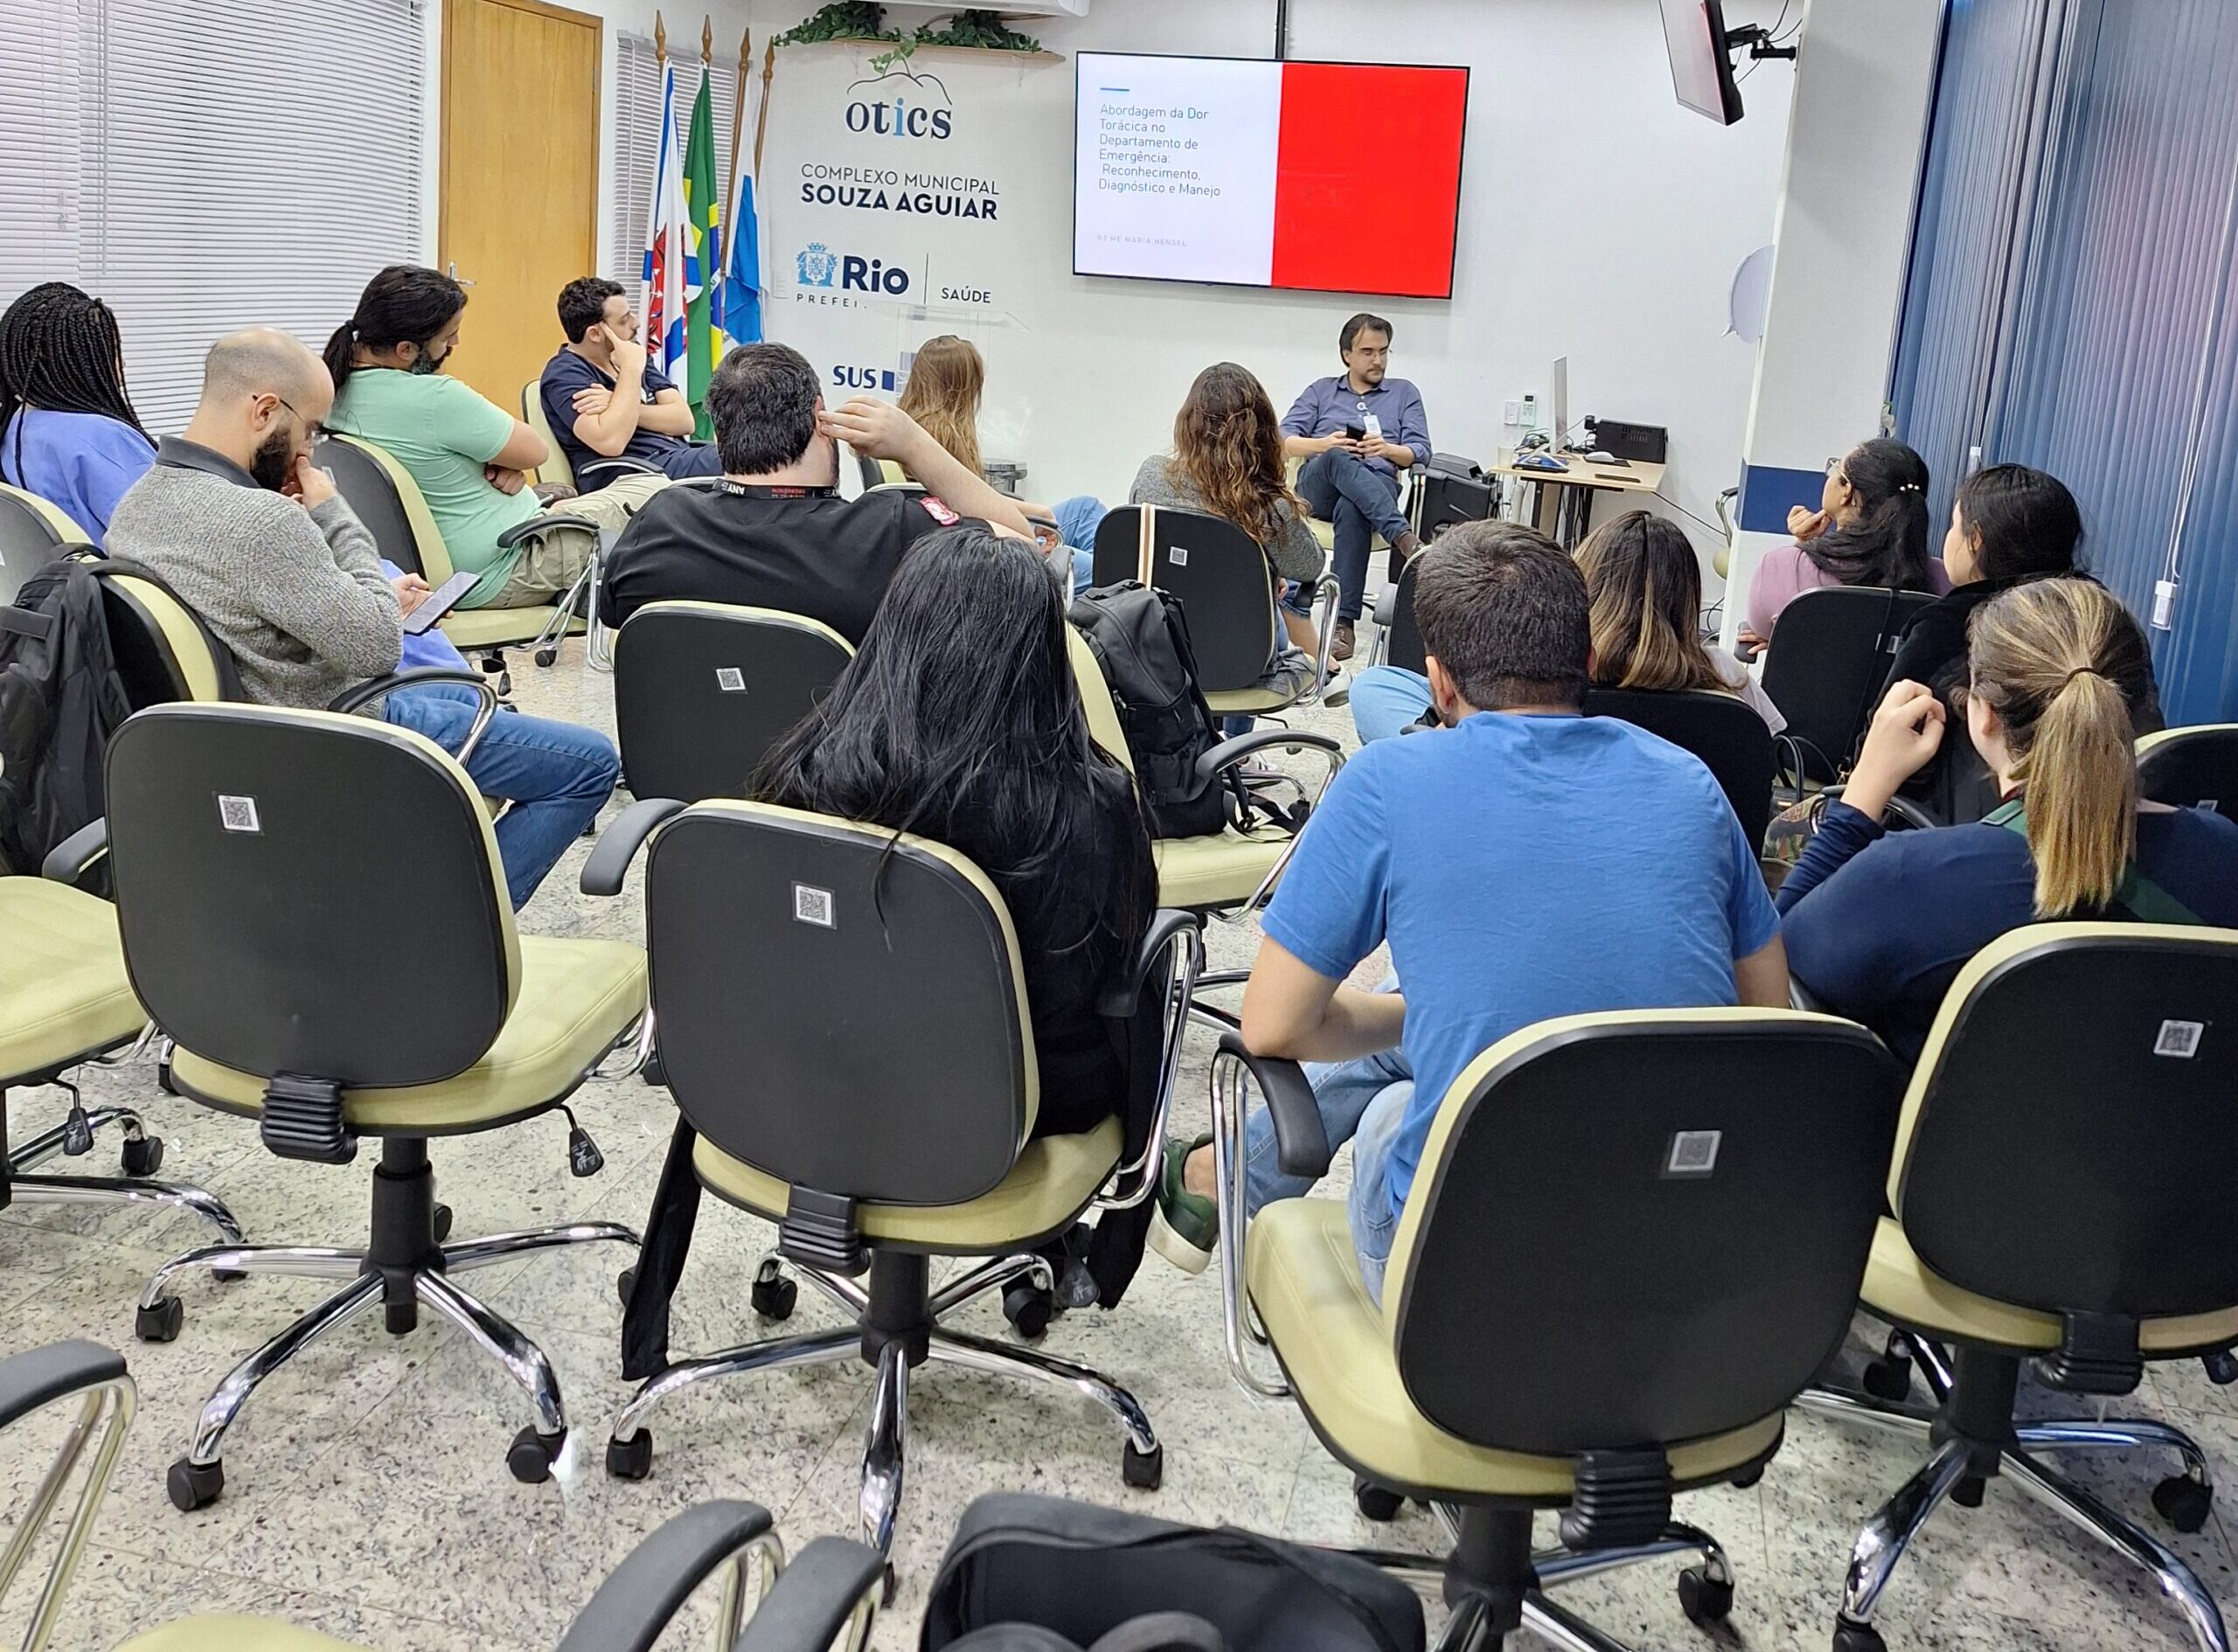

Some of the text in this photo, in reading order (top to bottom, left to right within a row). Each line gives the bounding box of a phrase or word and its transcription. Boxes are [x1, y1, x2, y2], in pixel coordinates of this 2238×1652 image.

[845, 97, 952, 140] otics
[1100, 102, 1210, 120] Abordagem da Dor
[1100, 118, 1166, 133] Torácica no
[1099, 133, 1199, 149] Departamento de
[1099, 148, 1171, 164] Emergência:
[801, 163, 1000, 196] COMPLEXO MUNICIPAL
[1102, 163, 1201, 181] Reconhecimento,
[1098, 177, 1220, 198] Diagnóstico e Manejo
[800, 182, 998, 221] SOUZA AGUIAR
[1124, 236, 1151, 245] MARIA
[842, 254, 909, 295] Rio
[796, 293, 867, 309] PREFEI
[941, 285, 991, 304] SAÚDE
[832, 364, 877, 390] SUS
